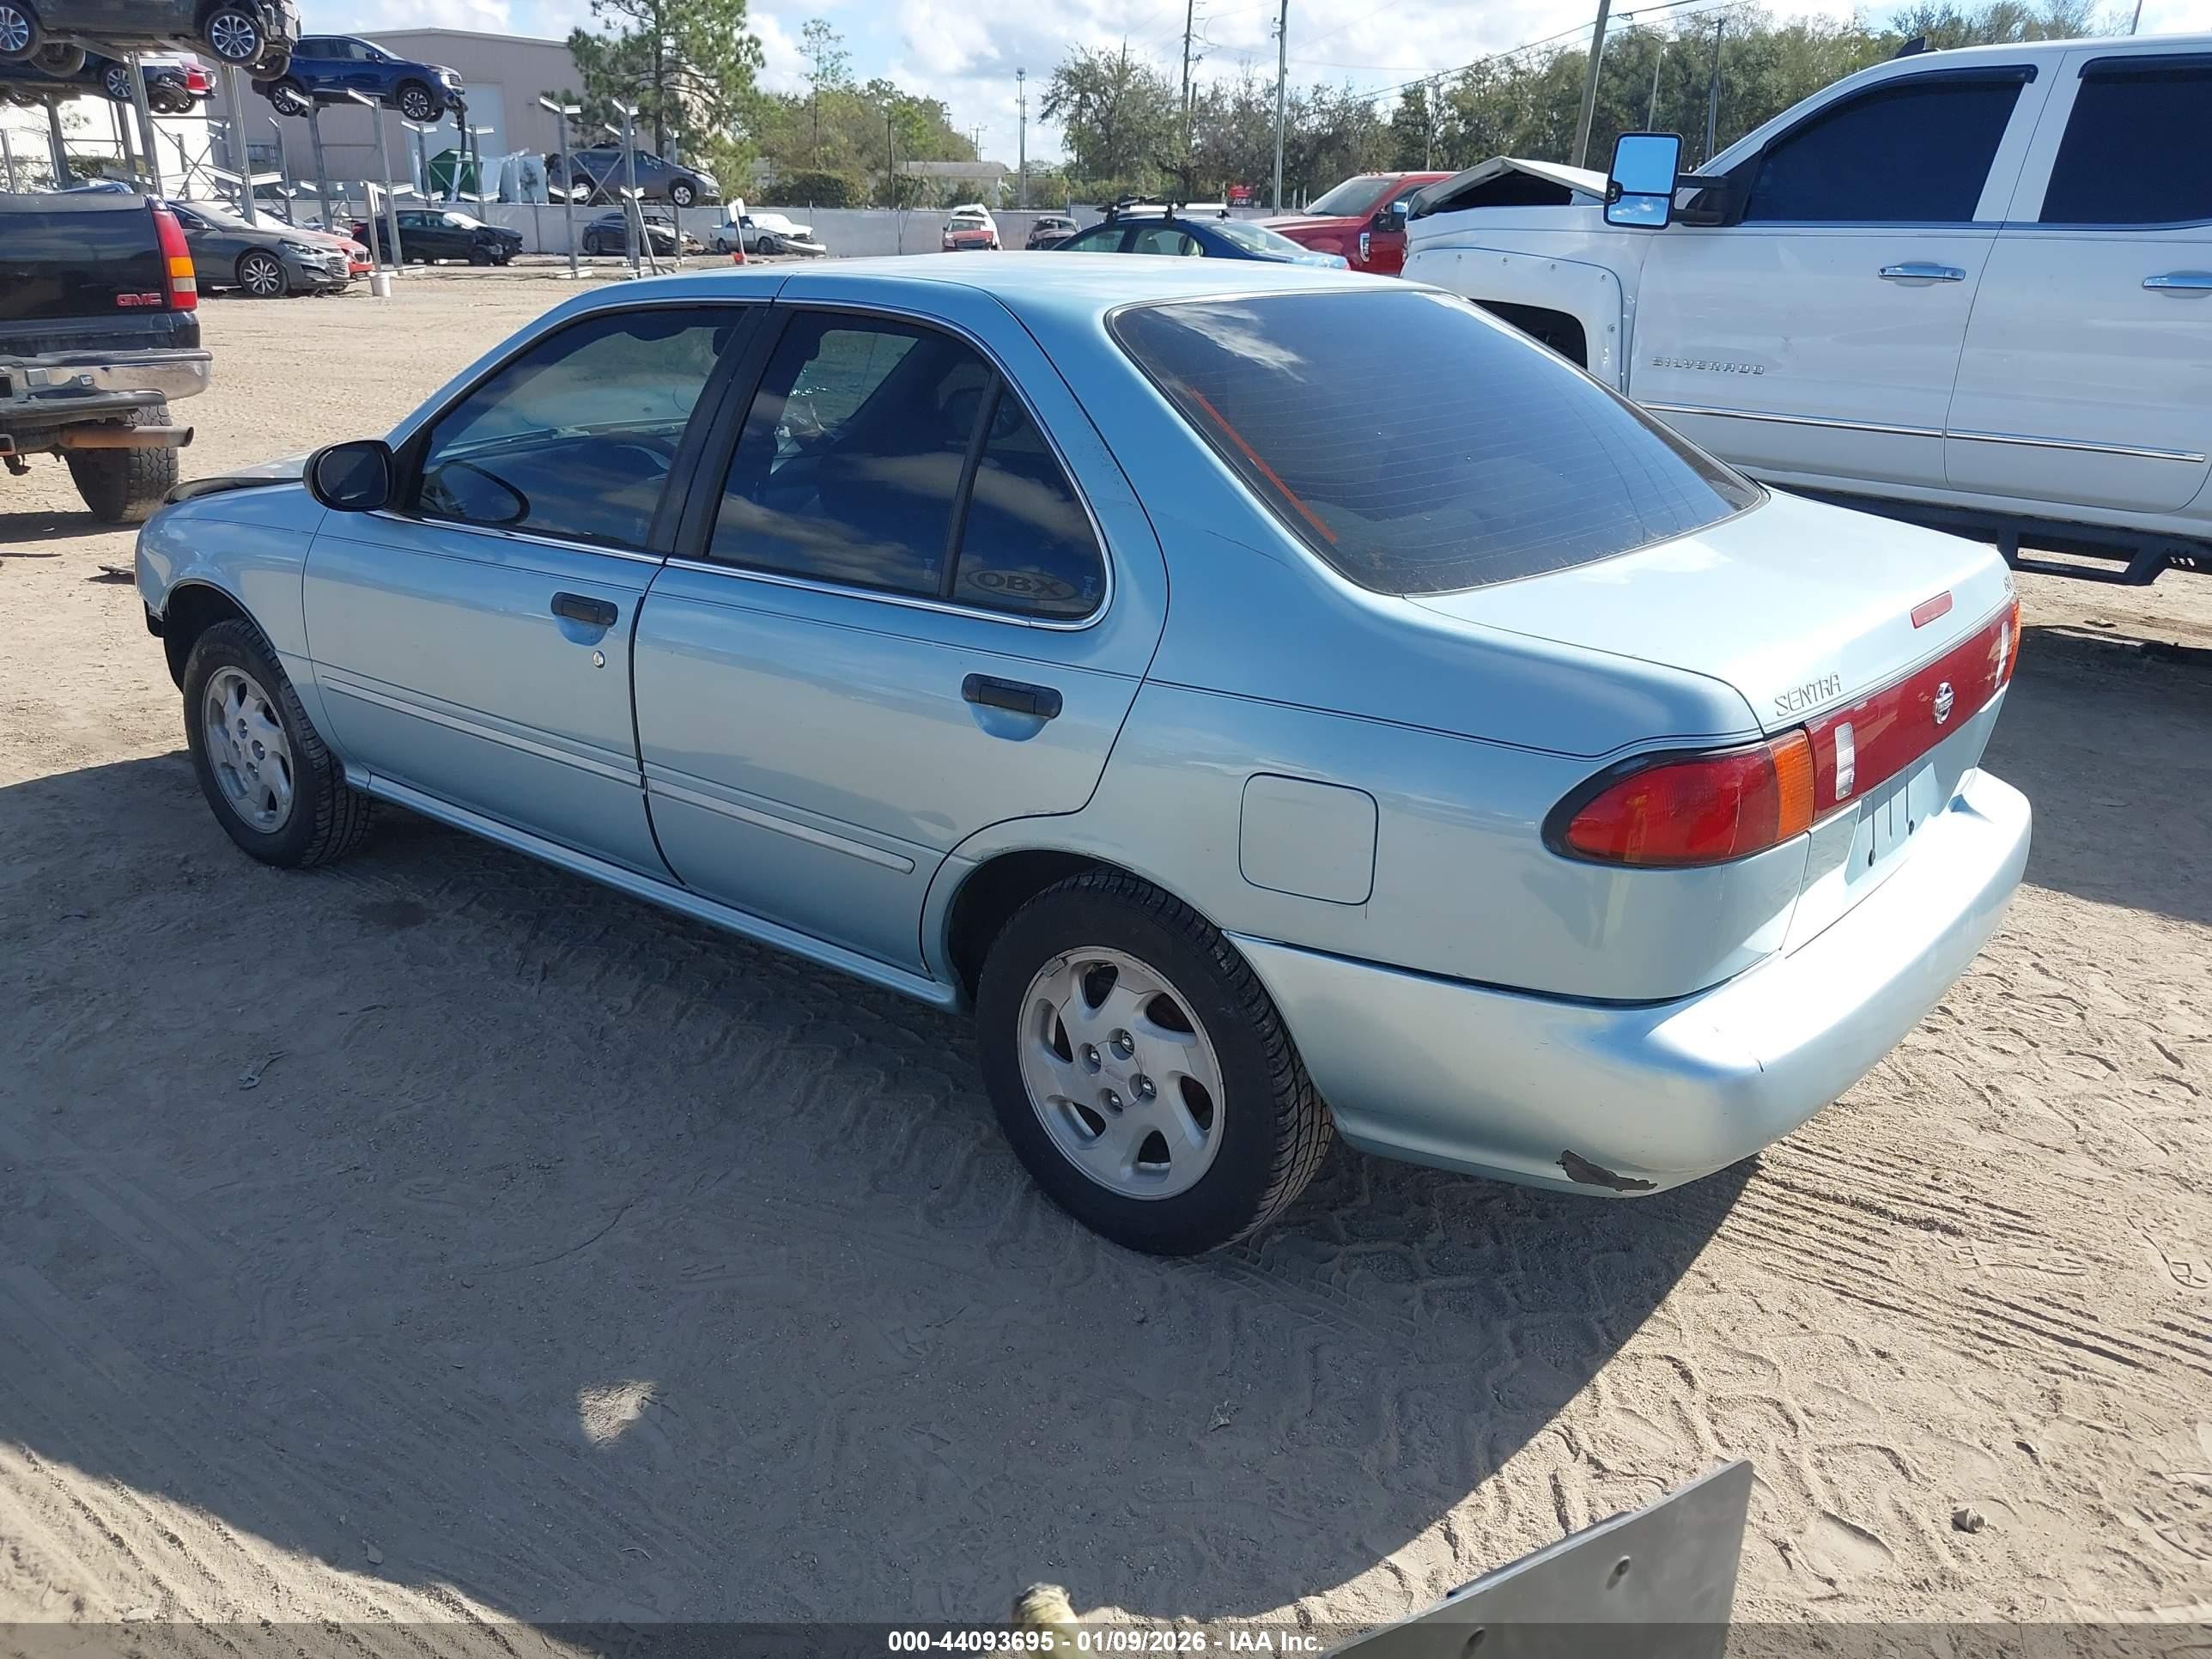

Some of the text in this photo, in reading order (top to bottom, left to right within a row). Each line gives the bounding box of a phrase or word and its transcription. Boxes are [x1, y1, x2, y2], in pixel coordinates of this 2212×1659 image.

[117, 293, 162, 306] GMC
[1652, 357, 1765, 374] SILVERADO
[977, 572, 1061, 596] OBX
[1774, 674, 1841, 716] SENTRA
